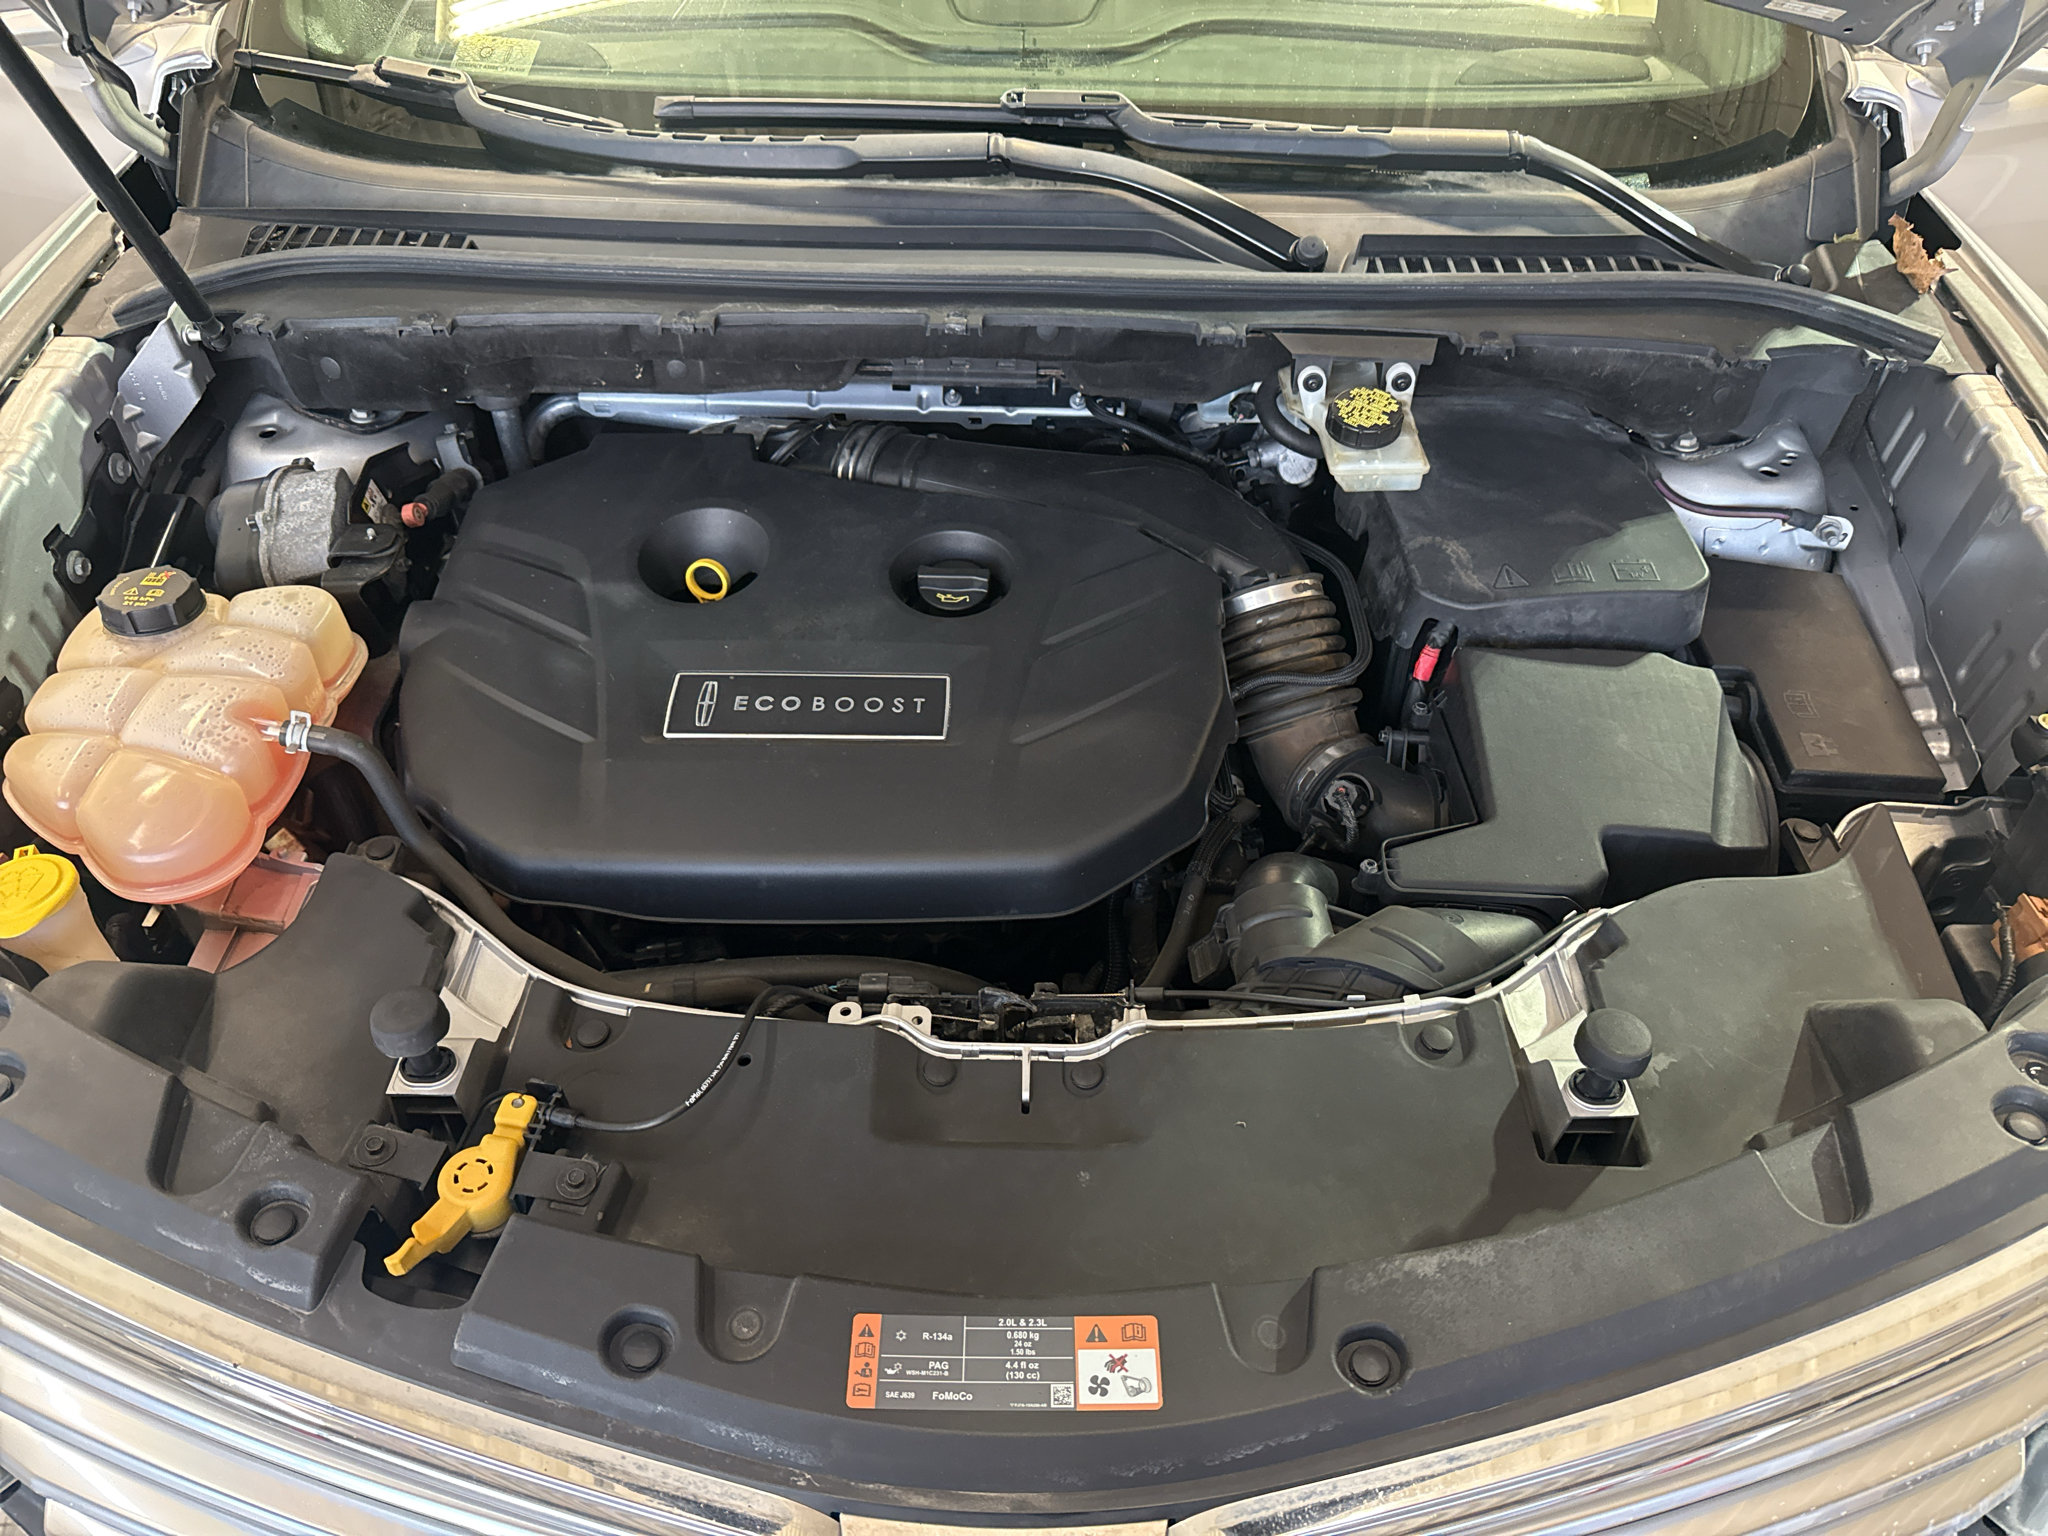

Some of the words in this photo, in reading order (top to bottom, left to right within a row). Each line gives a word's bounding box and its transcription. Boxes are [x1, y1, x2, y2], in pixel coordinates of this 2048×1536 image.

[733, 695, 926, 714] ECOBOOST
[998, 1318, 1017, 1327] 2.0L
[1019, 1318, 1026, 1327] &
[1028, 1318, 1047, 1327] 2.3L
[922, 1332, 953, 1341] R-134a
[1006, 1331, 1028, 1340] 0.680
[1029, 1331, 1040, 1341] kg
[928, 1361, 949, 1370] PAG
[1005, 1361, 1019, 1369] 4.4
[1020, 1361, 1027, 1369] fl
[1005, 1371, 1025, 1380] (130
[1026, 1371, 1040, 1380] cc)
[900, 1391, 916, 1399] J639
[932, 1391, 973, 1400] FoMoCo
